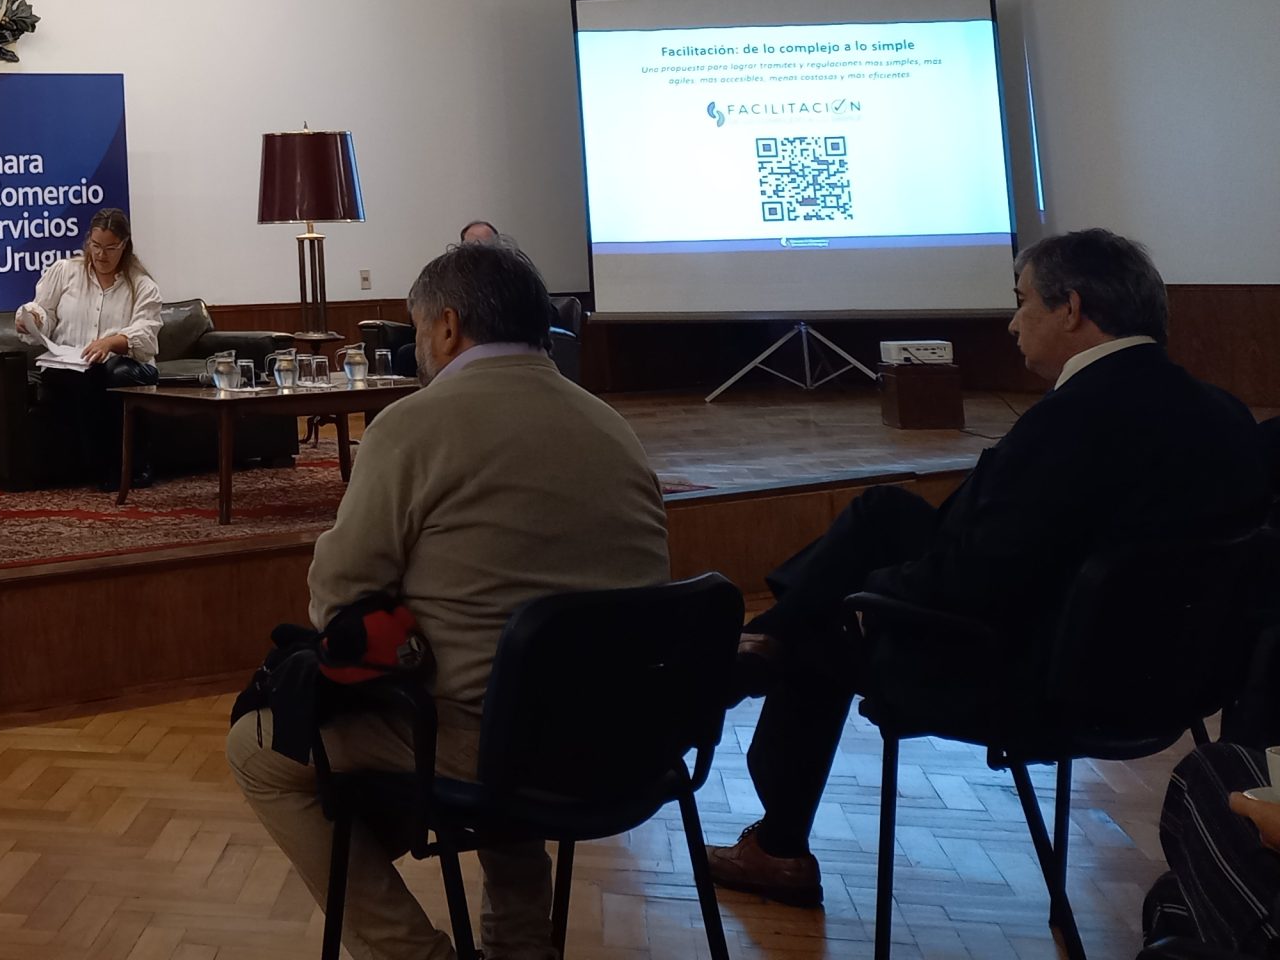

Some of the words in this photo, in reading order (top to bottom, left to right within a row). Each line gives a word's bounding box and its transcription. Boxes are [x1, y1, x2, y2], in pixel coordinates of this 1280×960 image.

[661, 44, 739, 56] Facilitación:
[743, 43, 759, 54] de
[763, 43, 775, 54] lo
[779, 41, 840, 55] complejo
[844, 43, 851, 52] a
[855, 40, 867, 51] lo
[871, 39, 915, 52] simple
[641, 66, 659, 74] Una
[661, 65, 705, 74] propuesta
[707, 64, 728, 72] para
[730, 62, 757, 71] lograr
[806, 60, 862, 70] regulaciones
[769, 74, 798, 83] menos
[800, 72, 838, 81] costosas
